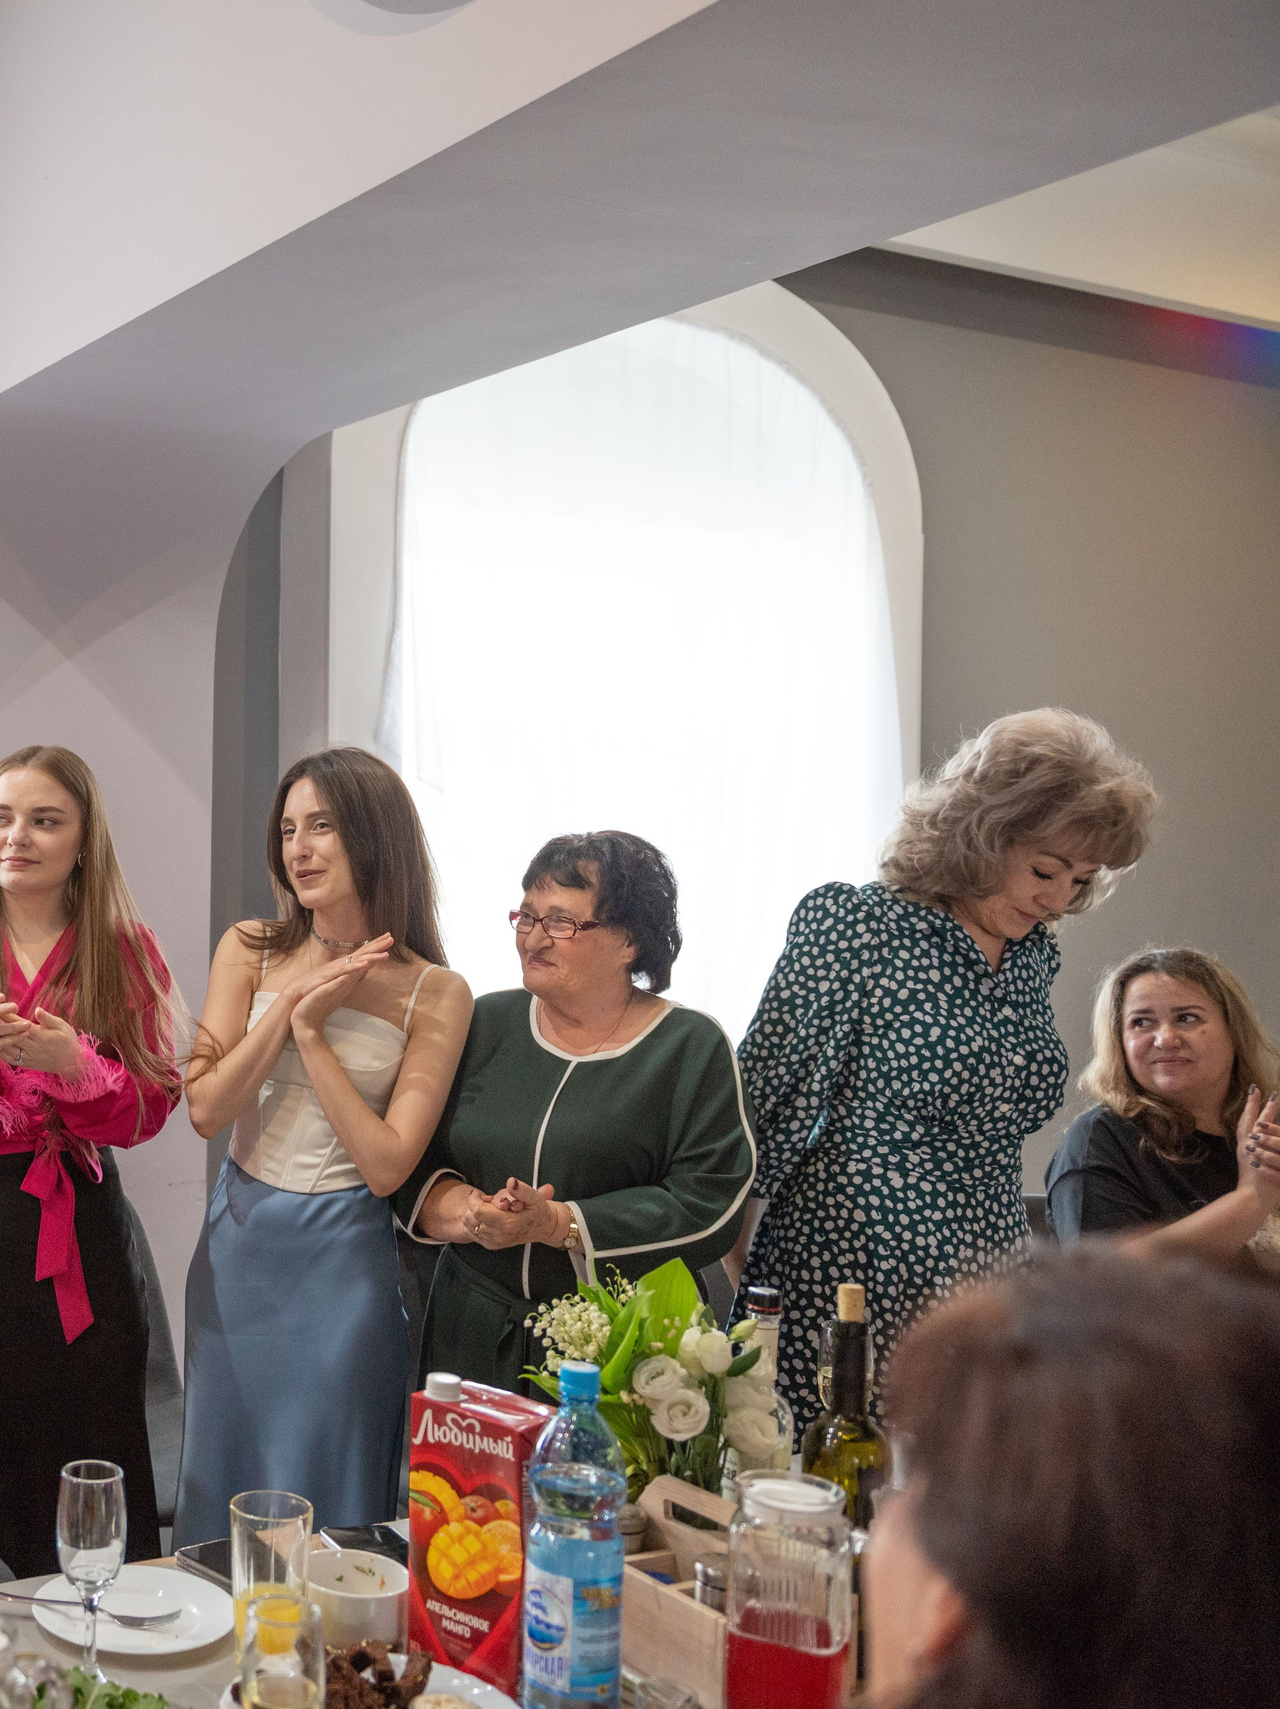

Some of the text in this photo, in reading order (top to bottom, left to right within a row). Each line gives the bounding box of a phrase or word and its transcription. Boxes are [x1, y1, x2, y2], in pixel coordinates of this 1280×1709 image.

[413, 1408, 515, 1461] Любимый
[426, 1598, 490, 1633] АПЕЛЬСИНОВОЕ
[442, 1616, 471, 1638] МАНГО
